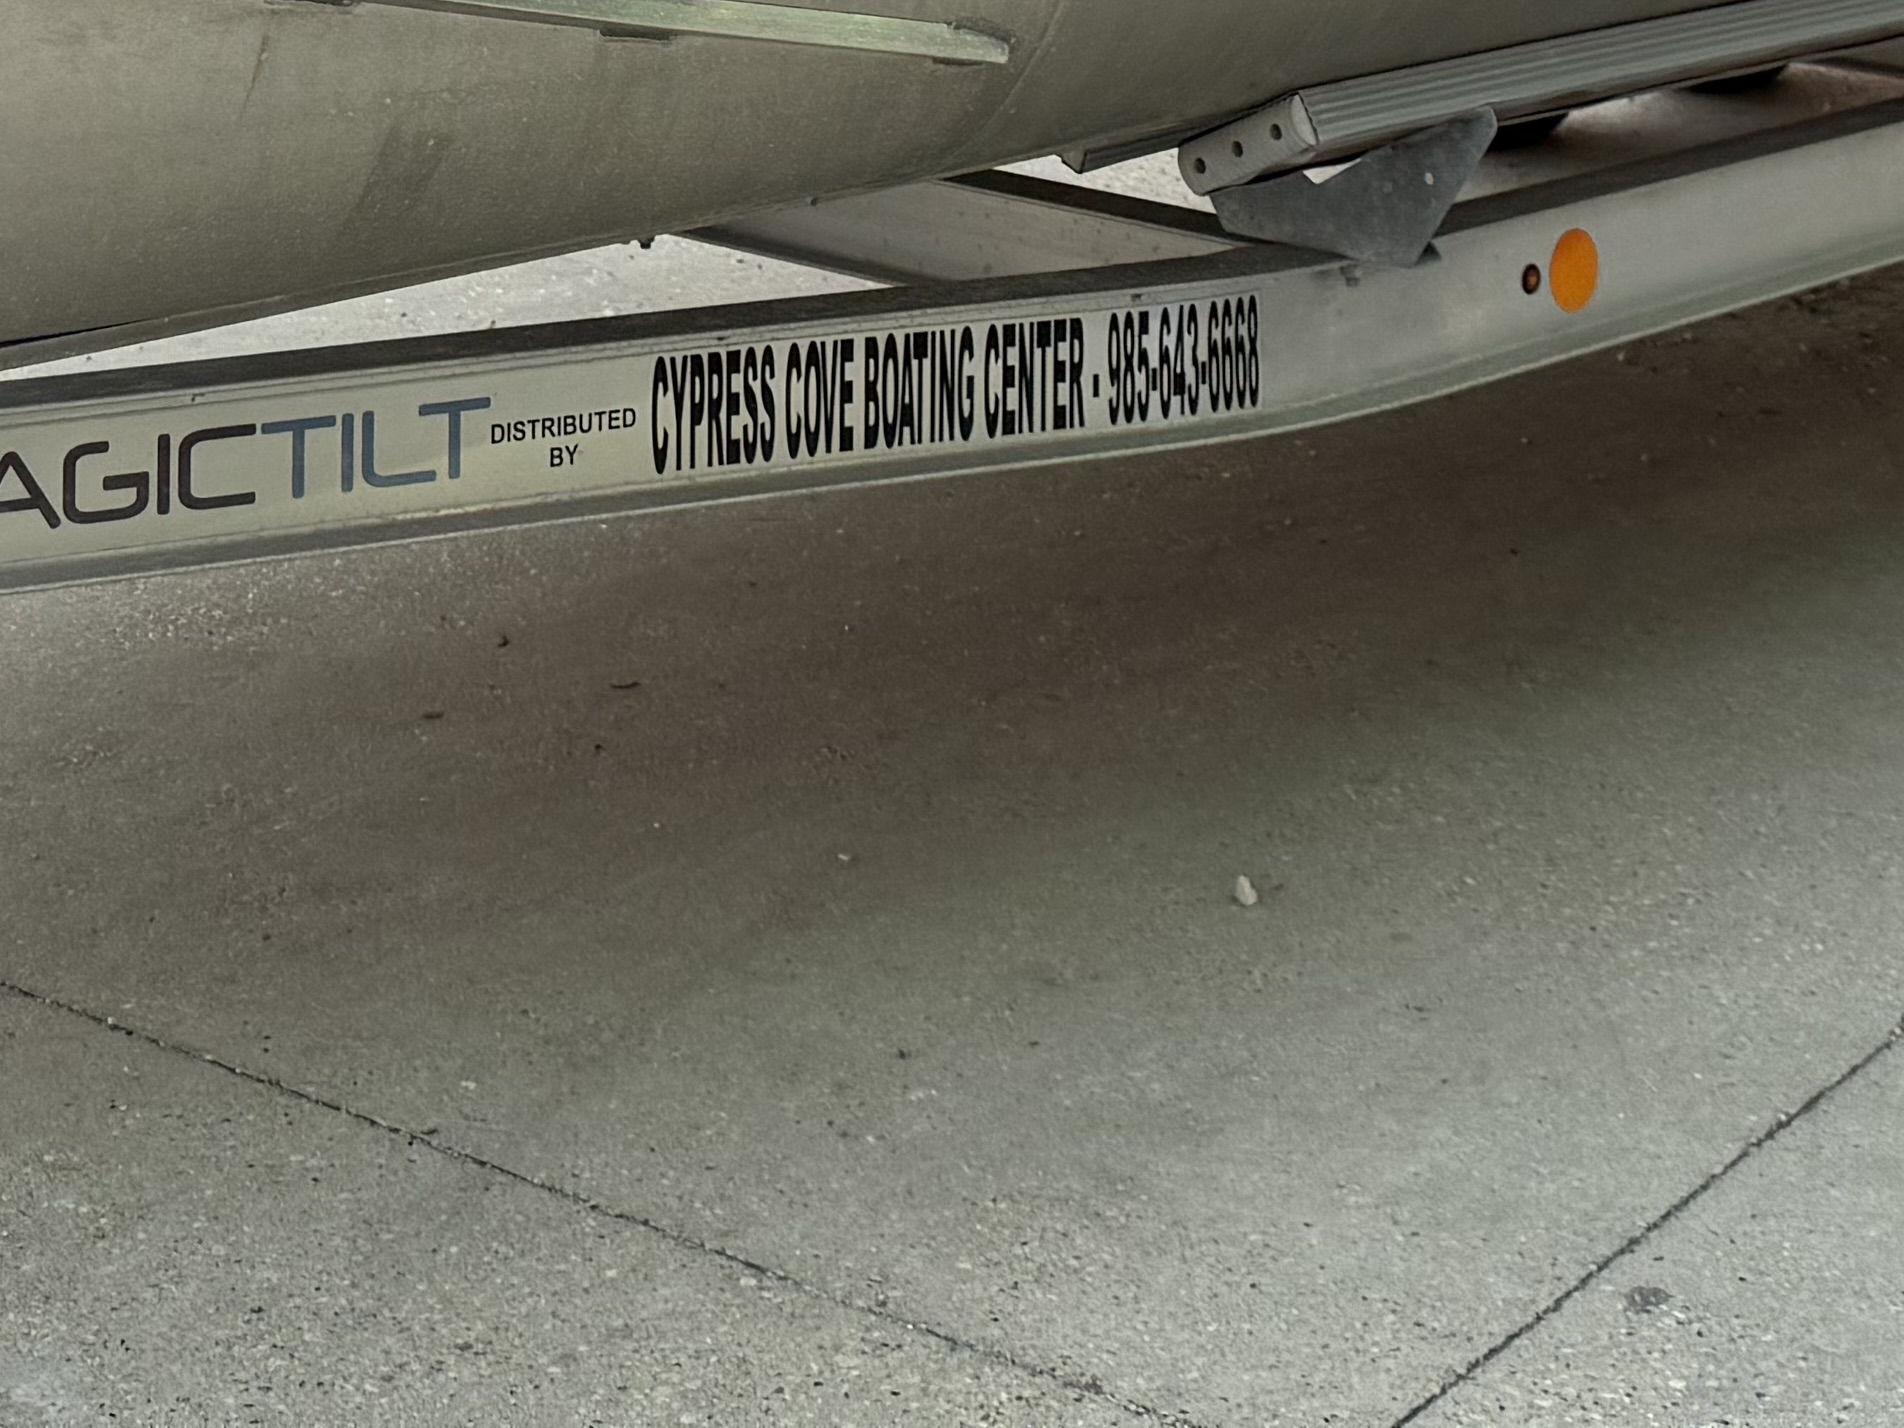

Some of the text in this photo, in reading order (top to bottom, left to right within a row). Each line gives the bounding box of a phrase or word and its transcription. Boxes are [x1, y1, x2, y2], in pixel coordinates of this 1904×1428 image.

[651, 294, 1260, 475] CYPRESS COVE BOATING CENTER - 985-643-6668
[490, 407, 637, 445] DISTRIBUTED
[549, 444, 579, 468] BY
